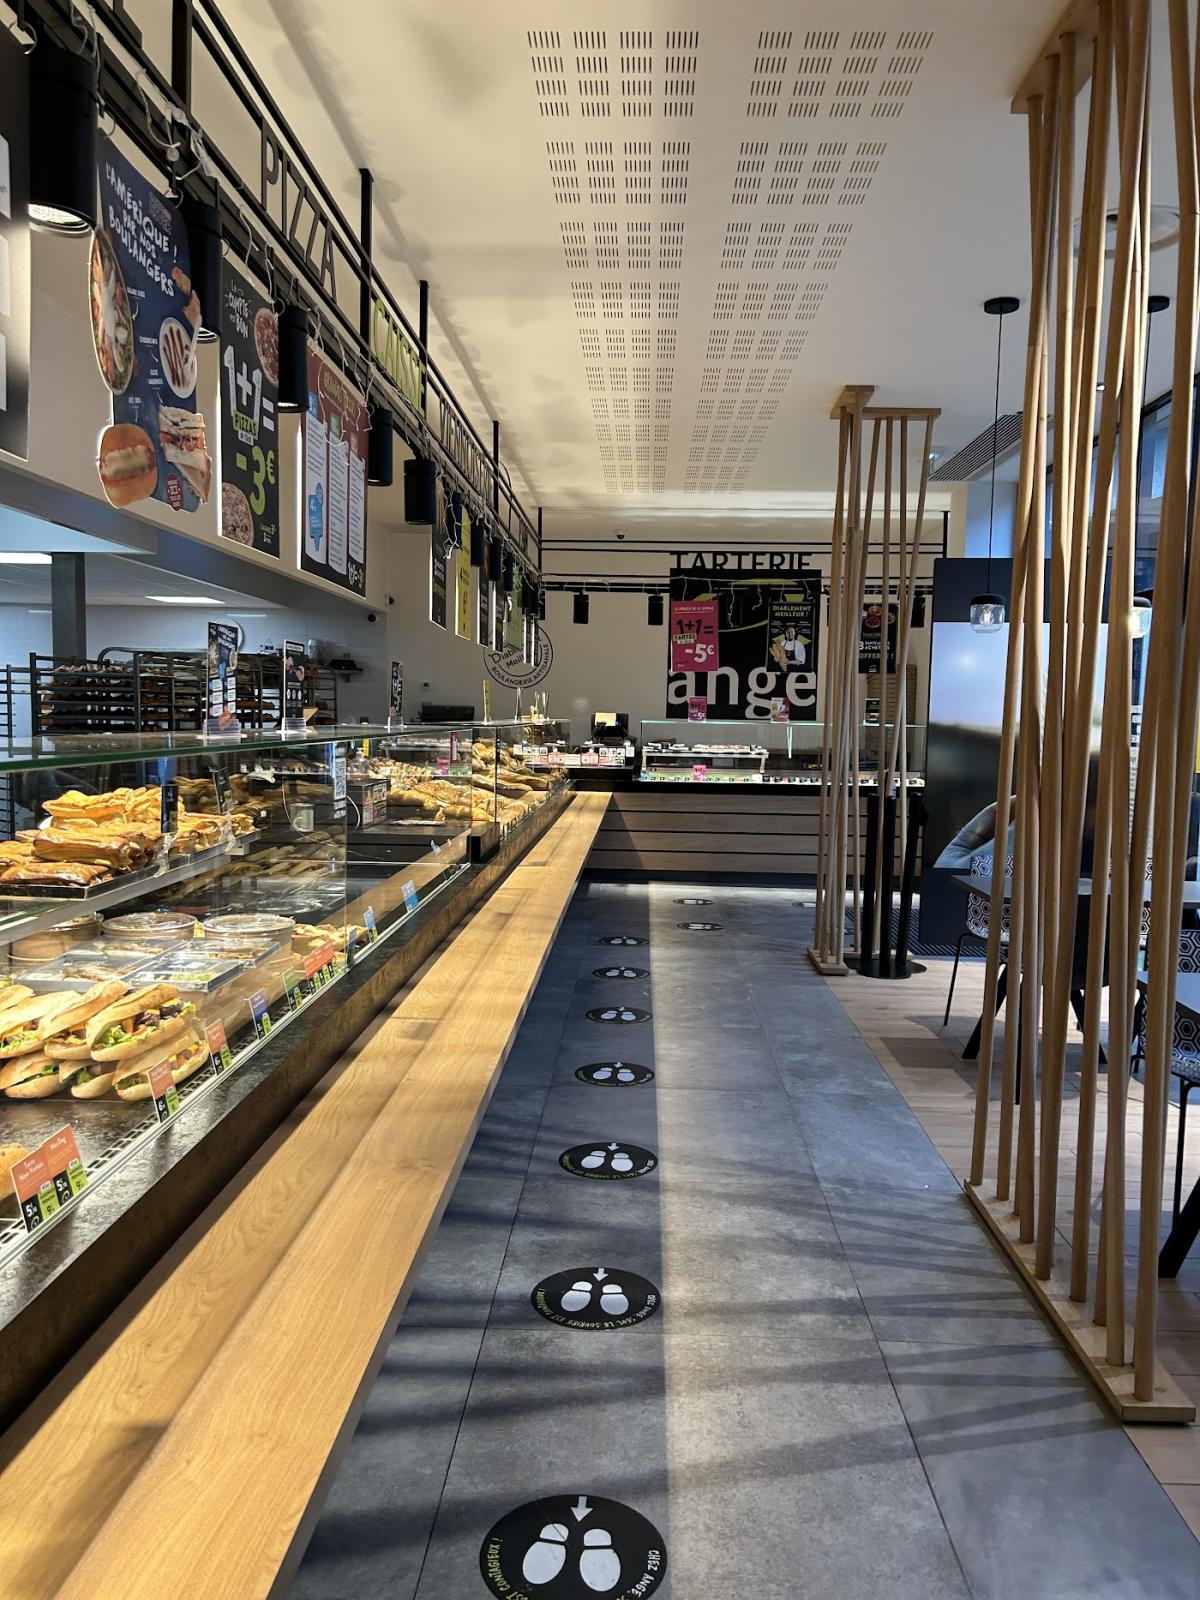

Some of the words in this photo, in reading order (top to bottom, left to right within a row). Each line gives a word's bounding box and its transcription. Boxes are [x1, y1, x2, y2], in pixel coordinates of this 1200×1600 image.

[260, 116, 337, 304] PIZZA
[108, 204, 175, 297] BOULANGERS
[140, 235, 156, 259] NOS
[234, 411, 257, 437] PIZZAS
[669, 552, 812, 570] TARTERIE
[491, 666, 533, 686] BOULANGERIE
[533, 643, 550, 681] ARTISANALE
[667, 666, 817, 719] ange
[567, 1318, 601, 1328] SOURIRE
[486, 1543, 512, 1592] CONTAGIEUX
[647, 1549, 661, 1571] CHEZ
